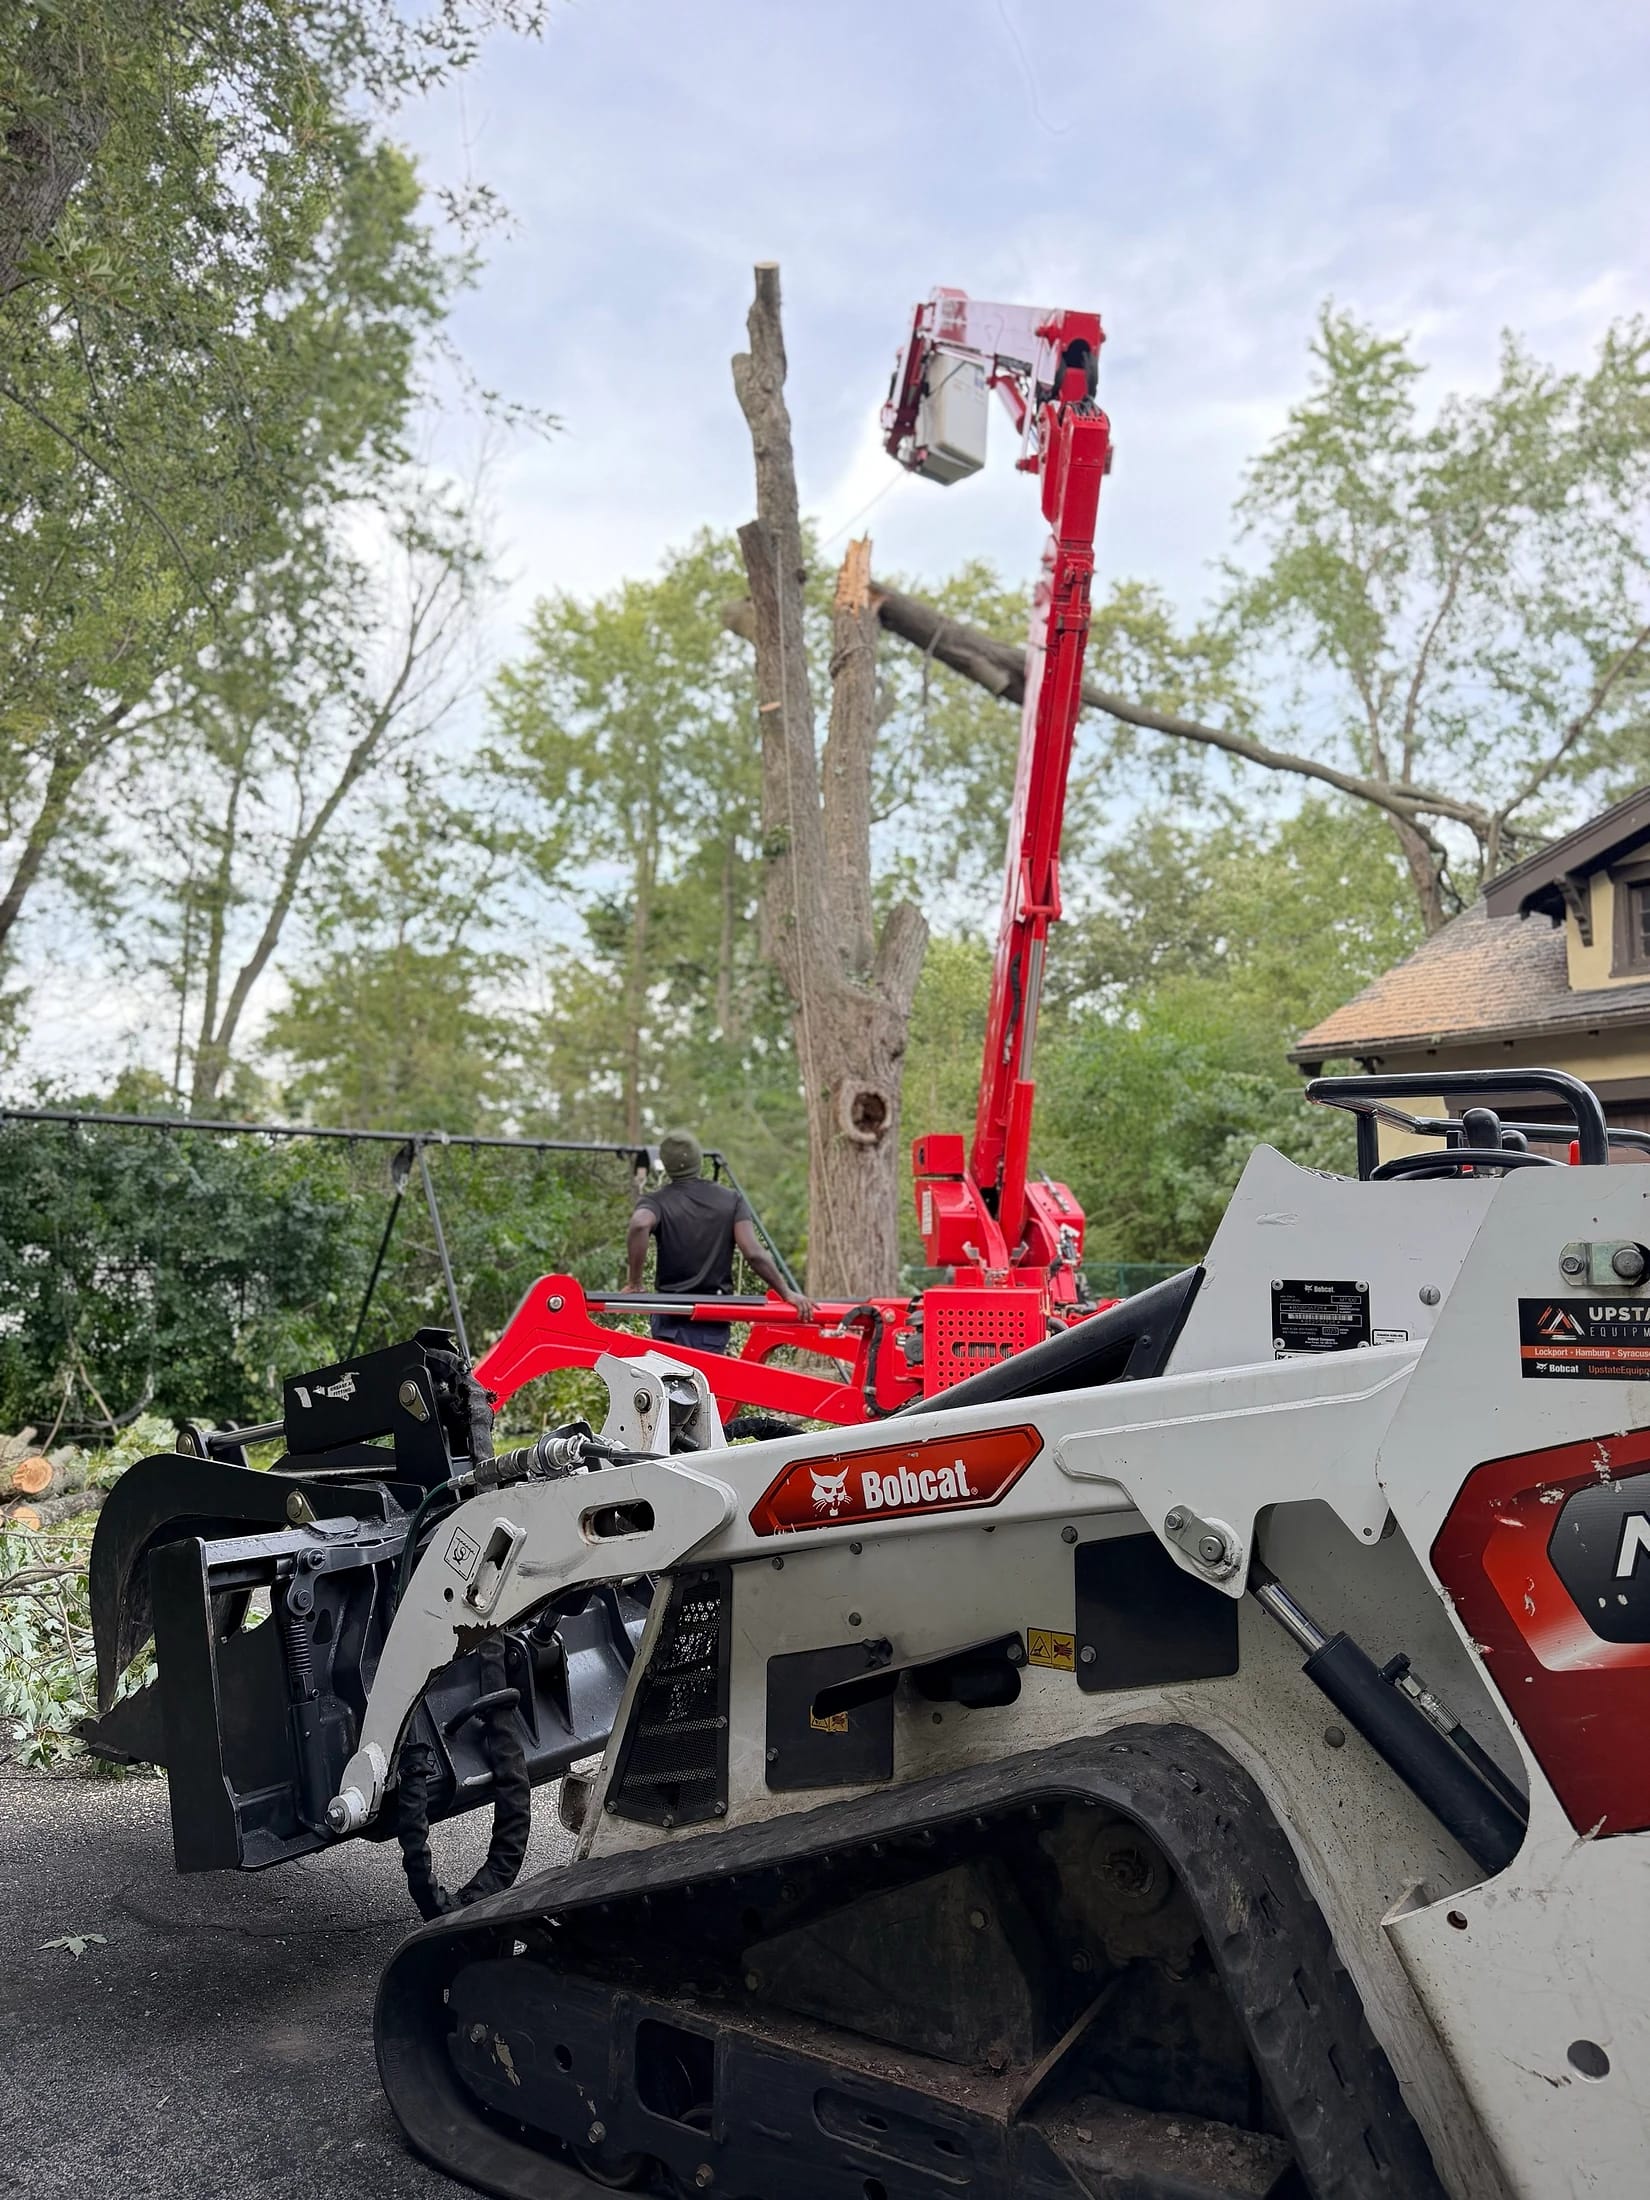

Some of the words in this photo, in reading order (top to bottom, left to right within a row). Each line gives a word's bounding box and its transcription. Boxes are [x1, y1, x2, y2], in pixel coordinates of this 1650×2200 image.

[1534, 1348, 1568, 1357] Lockport
[1575, 1349, 1610, 1358] Hamburg
[1617, 1349, 1650, 1359] Syracus
[1549, 1364, 1579, 1373] Bobcat
[861, 1459, 970, 1510] Bobcat
